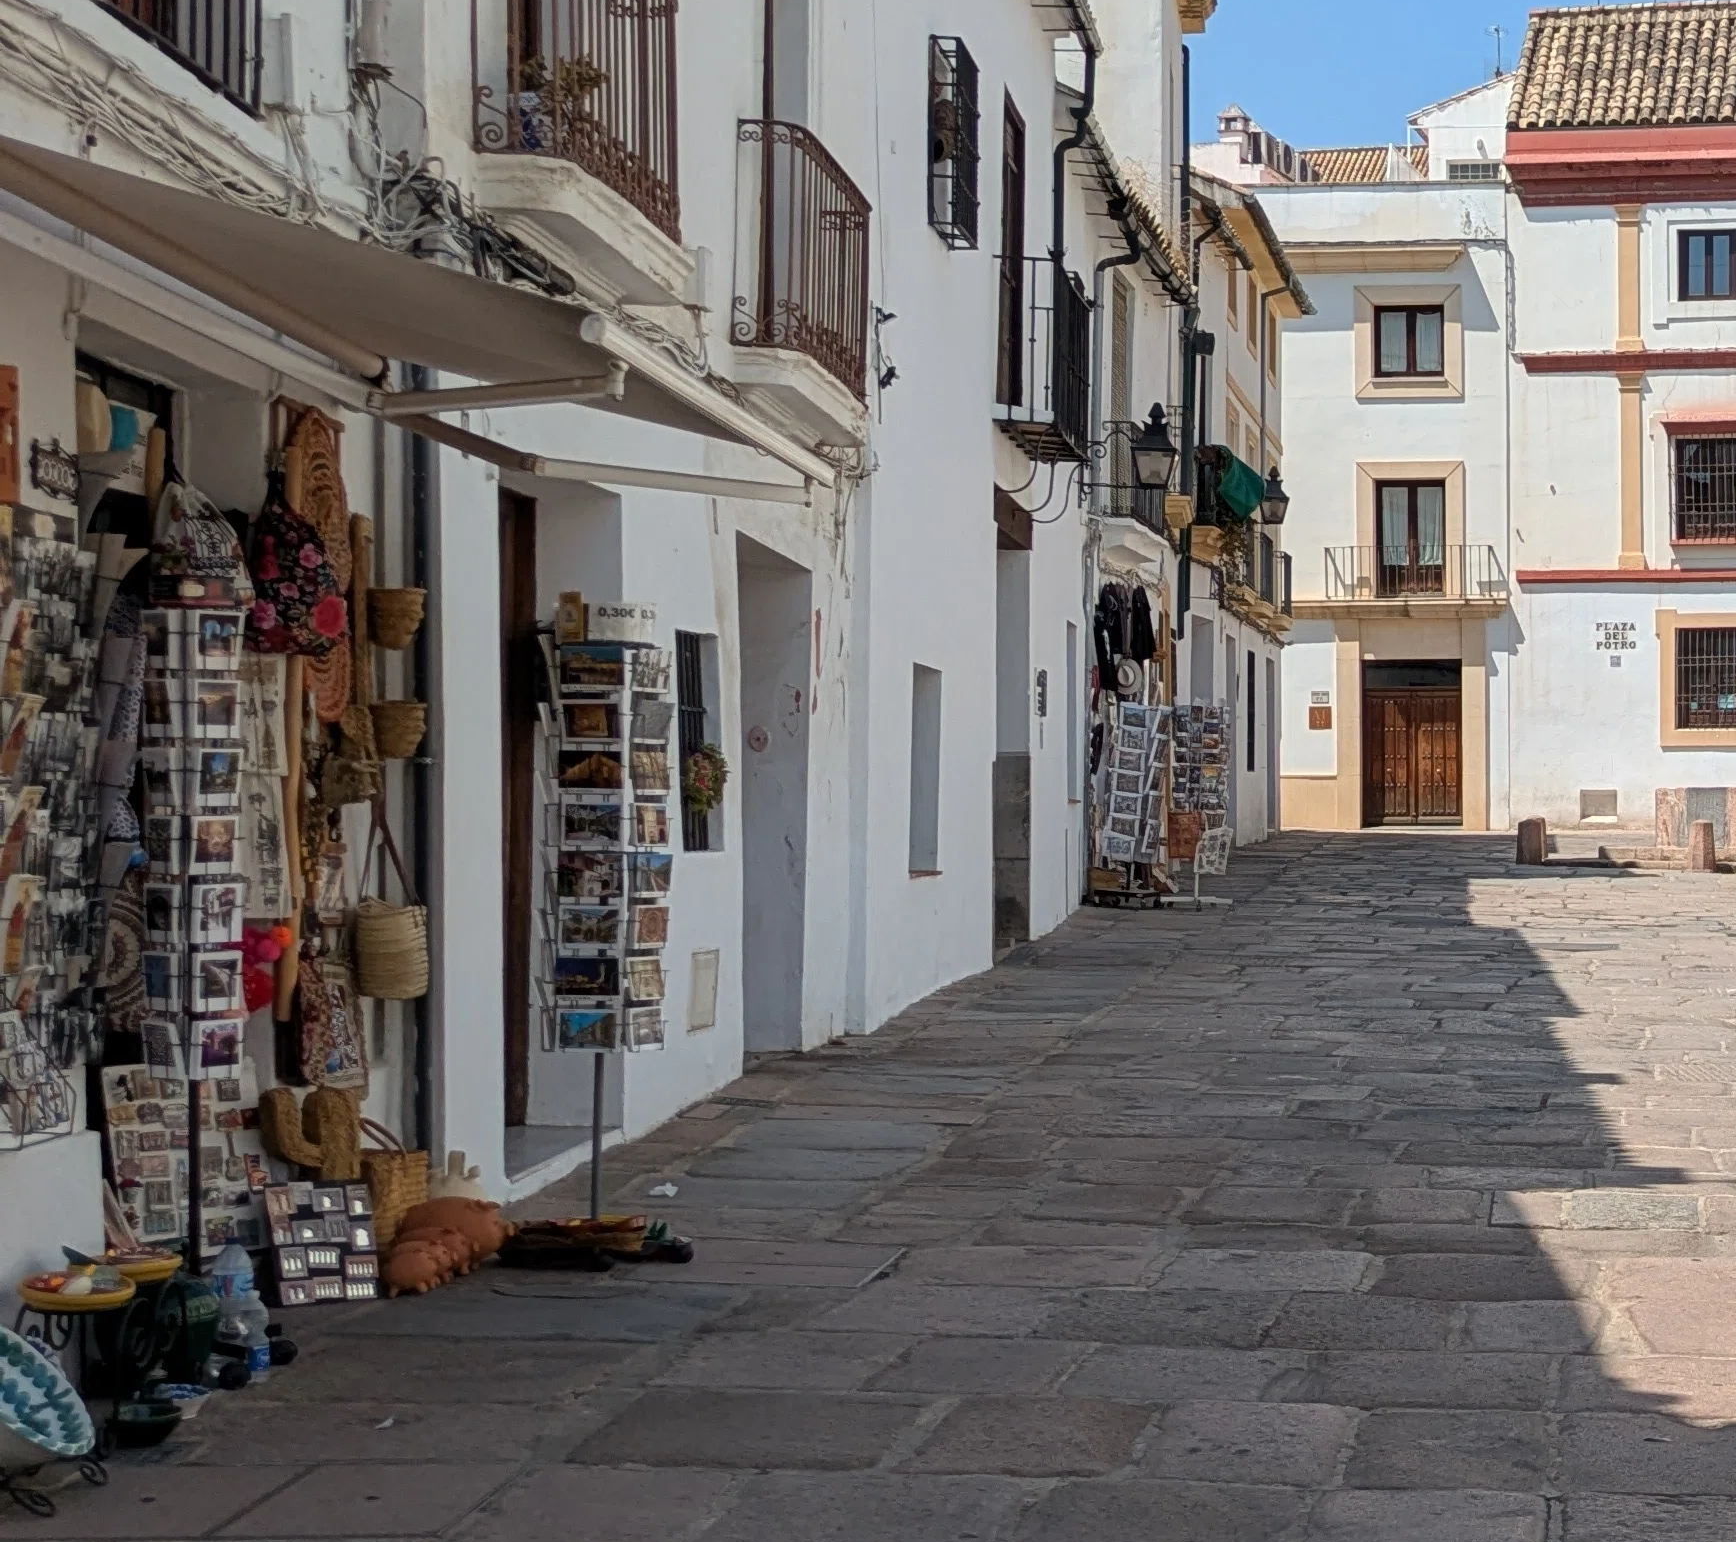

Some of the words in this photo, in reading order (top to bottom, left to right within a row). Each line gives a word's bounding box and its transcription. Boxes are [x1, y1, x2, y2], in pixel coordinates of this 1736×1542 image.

[597, 606, 635, 619] 0,30€
[1596, 622, 1636, 631] PLAZA
[1605, 631, 1628, 640] DEL
[1596, 641, 1636, 650] POTRO
